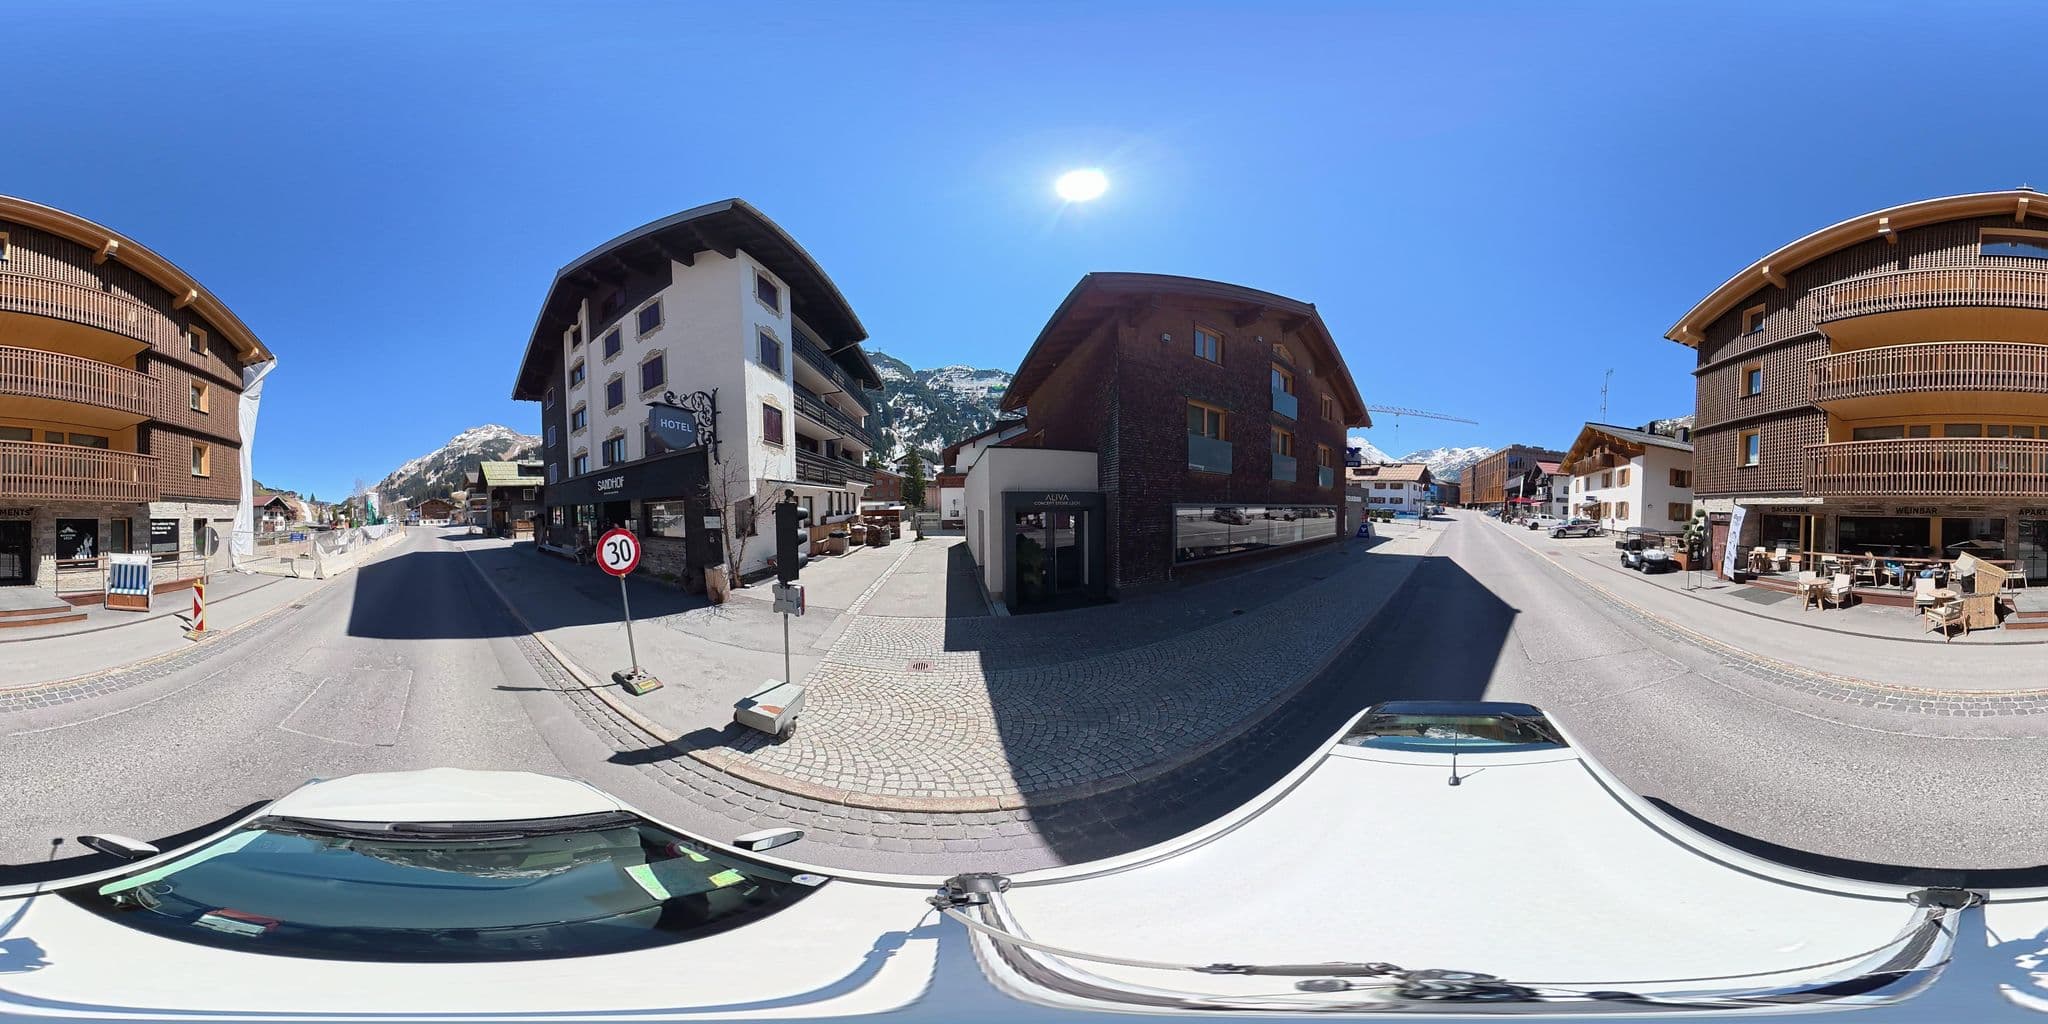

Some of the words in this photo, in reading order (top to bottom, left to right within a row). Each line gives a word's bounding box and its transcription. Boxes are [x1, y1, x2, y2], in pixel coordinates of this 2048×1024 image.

[660, 418, 693, 433] HOTEL
[597, 476, 624, 491] SANDHOF
[1895, 507, 1938, 515] WEINBAR
[607, 539, 632, 565] 30
